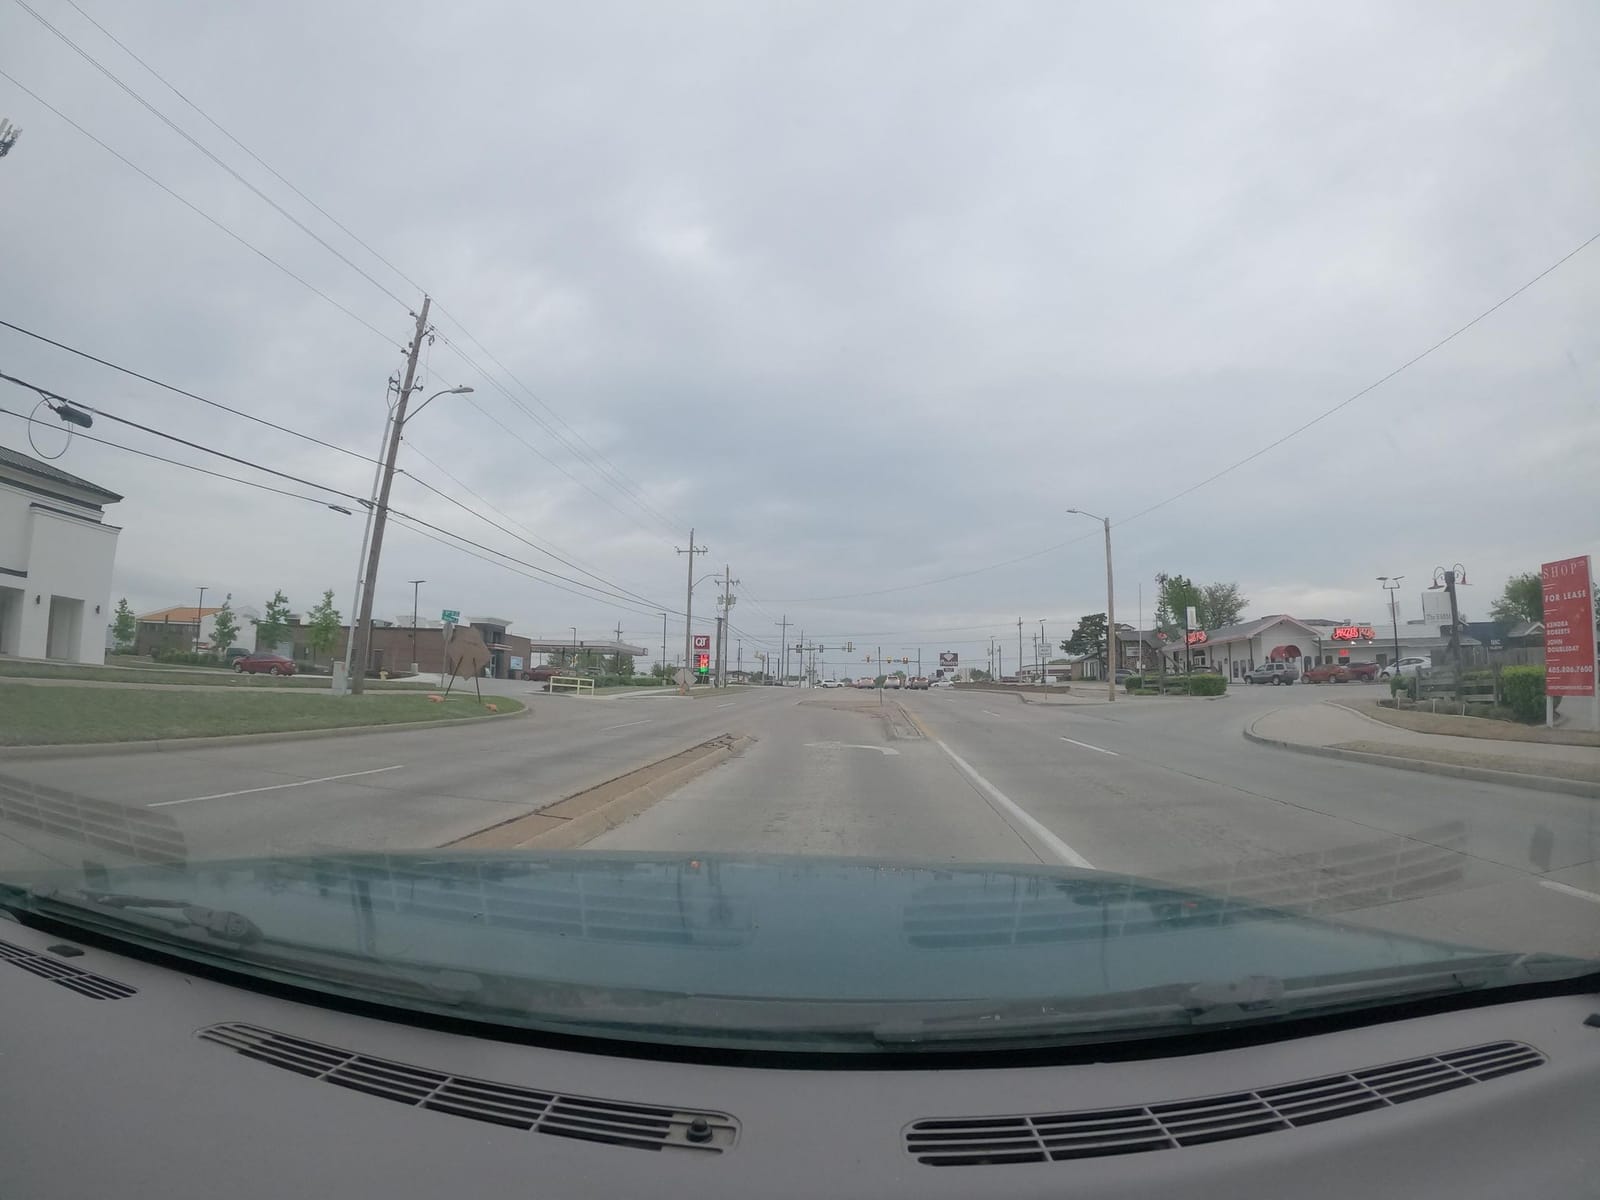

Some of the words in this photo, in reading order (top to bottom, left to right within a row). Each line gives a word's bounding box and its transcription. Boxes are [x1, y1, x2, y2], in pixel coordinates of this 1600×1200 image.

[1543, 562, 1577, 579] SHOP
[1545, 593, 1560, 602] FOR
[1563, 589, 1586, 600] LEASE
[696, 637, 706, 647] QT
